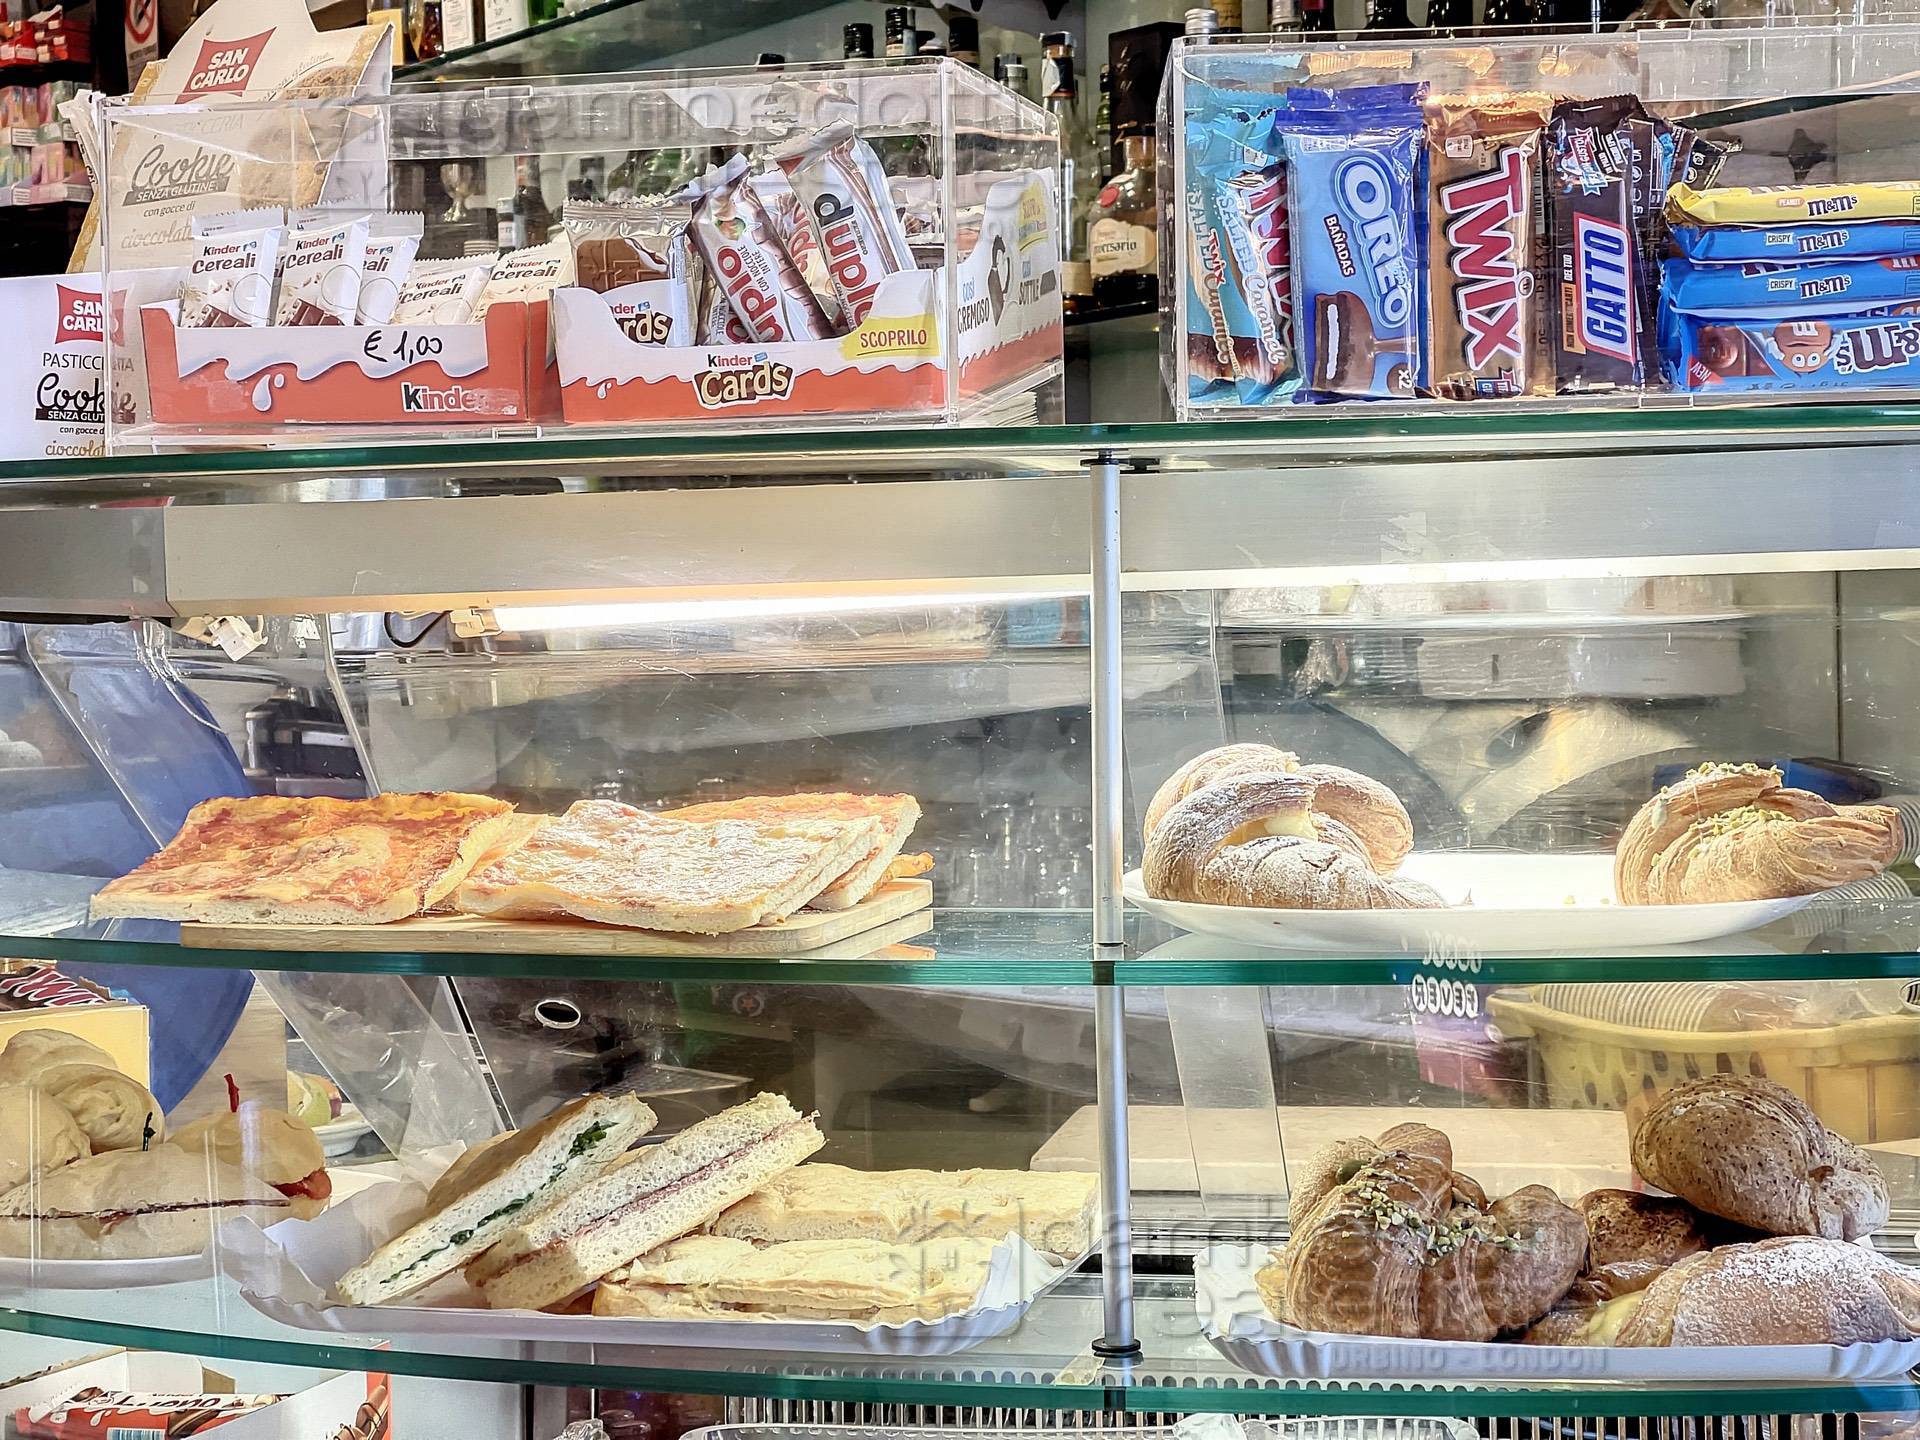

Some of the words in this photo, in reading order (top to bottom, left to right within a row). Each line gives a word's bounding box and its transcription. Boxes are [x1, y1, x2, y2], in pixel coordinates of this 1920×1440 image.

[208, 47, 249, 70] SAN
[190, 64, 250, 91] CARLO
[131, 144, 235, 189] Cookie
[136, 187, 168, 202] SENZA
[143, 208, 161, 218] con
[160, 205, 184, 217] gocce
[296, 236, 330, 251] Kinder
[1326, 216, 1355, 276] BAÑADAS
[1344, 163, 1412, 324] OREO
[1767, 234, 1791, 244] CRISPY
[203, 244, 241, 257] Kinder
[285, 244, 344, 269] Cereali
[192, 252, 256, 274] Cereali
[491, 266, 558, 281] Cereali
[1583, 229, 1628, 344] GATTO
[1770, 280, 1794, 289] CRISPY
[957, 297, 990, 334] CREMOSO
[364, 330, 388, 362] €
[393, 330, 443, 363] 1,00
[860, 329, 928, 348] SCOPRILO
[707, 354, 753, 368] Kinder
[700, 362, 789, 406] Cards
[48, 411, 78, 420] SENZA
[76, 427, 97, 435] gocce
